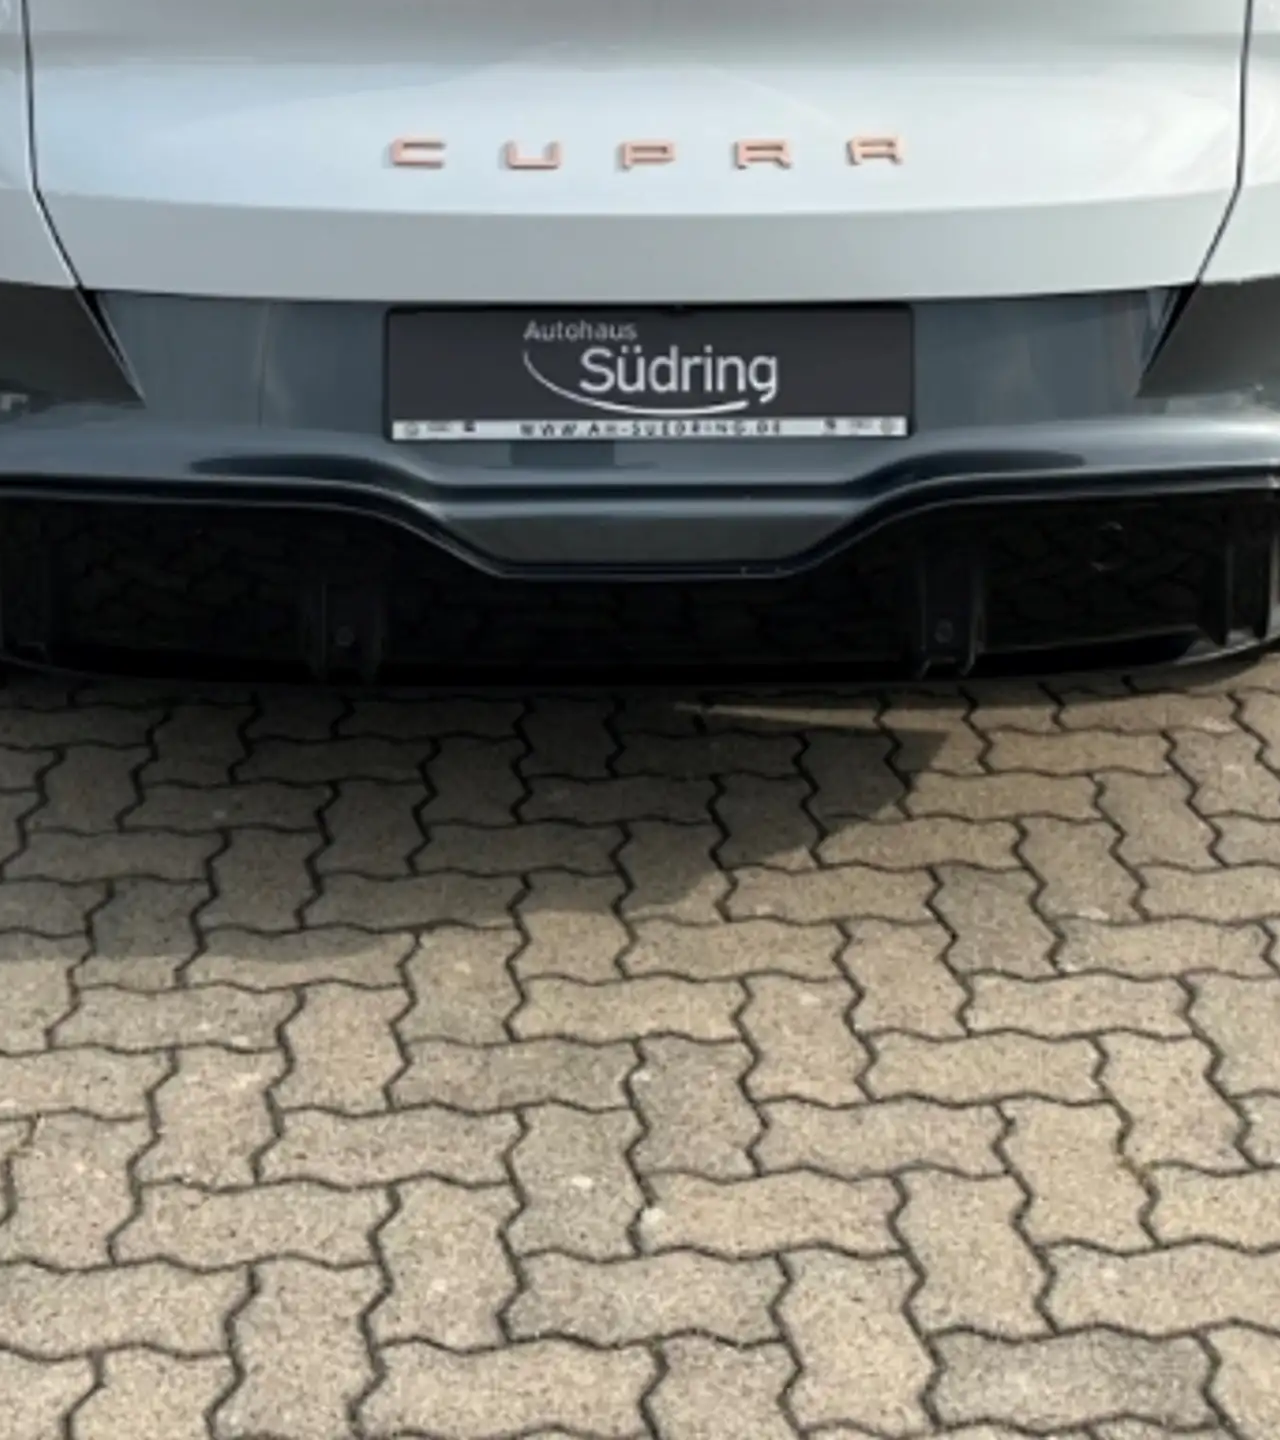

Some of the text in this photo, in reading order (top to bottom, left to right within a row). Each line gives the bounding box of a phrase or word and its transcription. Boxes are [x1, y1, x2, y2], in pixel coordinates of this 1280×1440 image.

[388, 133, 903, 171] CUPRA
[523, 319, 638, 341] Autohaus
[578, 344, 778, 404] Südring
